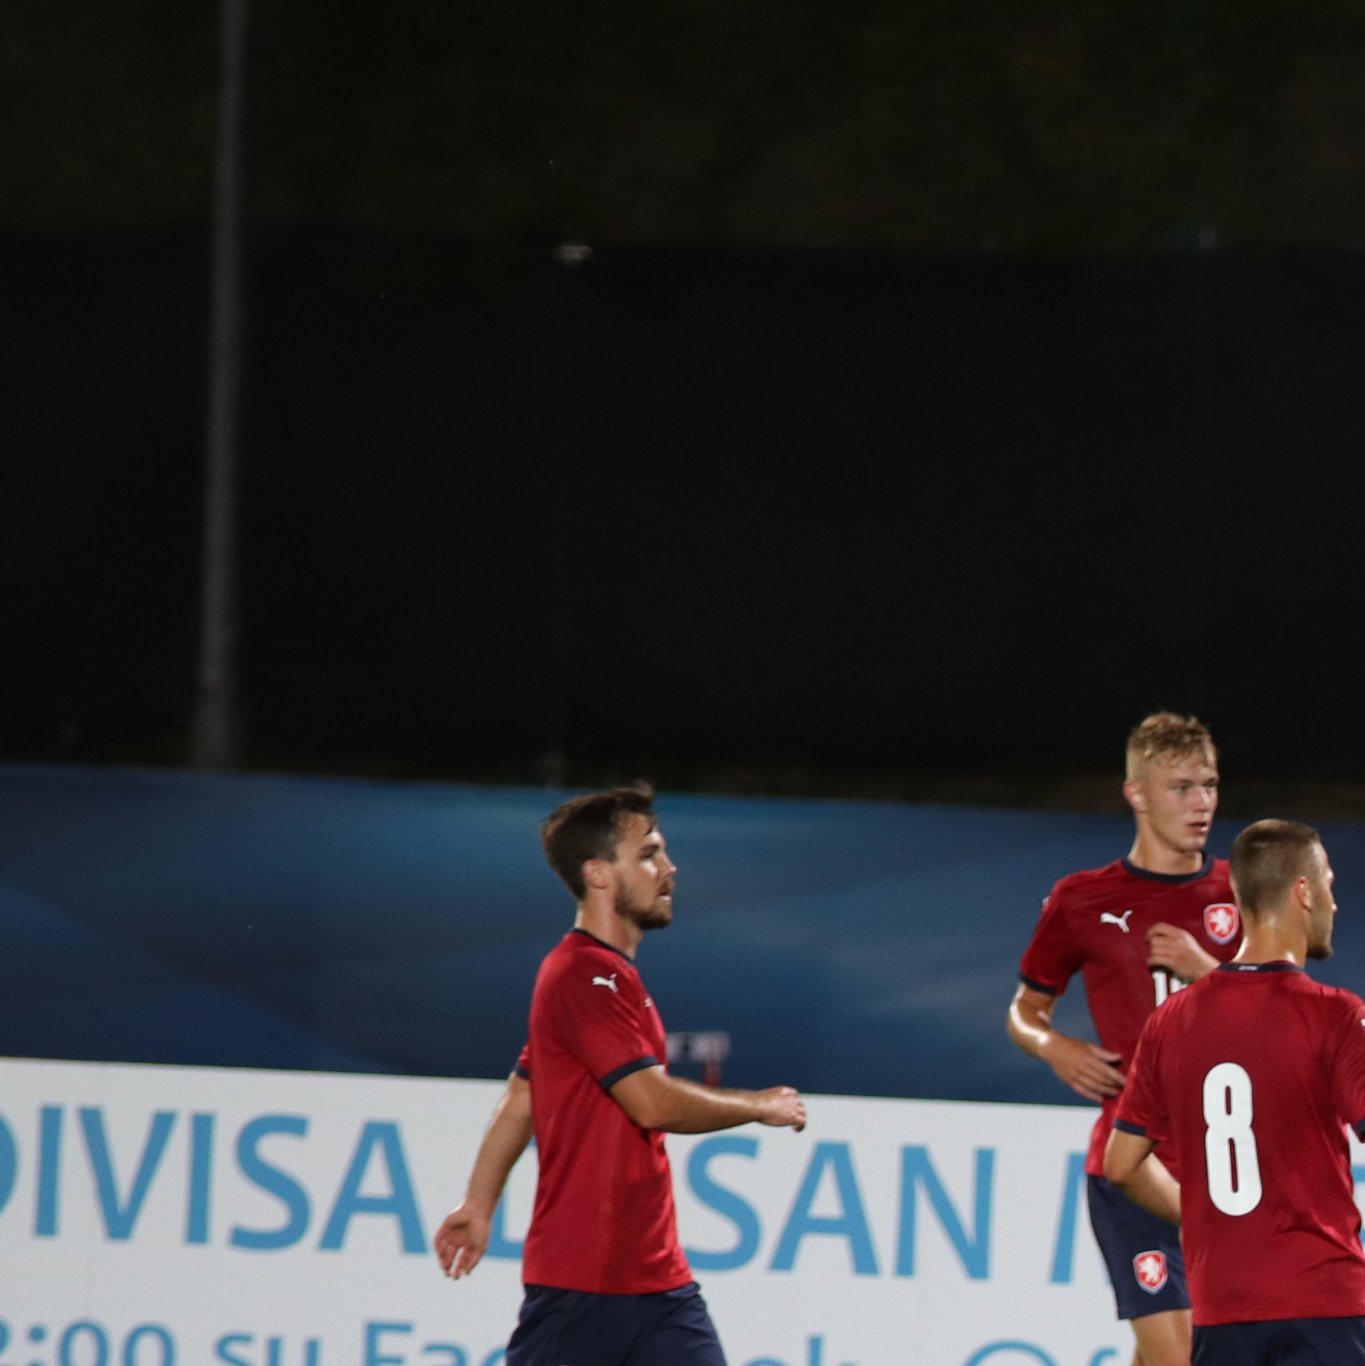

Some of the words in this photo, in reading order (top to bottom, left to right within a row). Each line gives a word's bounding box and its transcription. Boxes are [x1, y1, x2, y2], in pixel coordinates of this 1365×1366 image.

[0, 1104, 427, 1254] IVISA
[686, 1134, 994, 1281] SAN
[1203, 1062, 1263, 1216] 8
